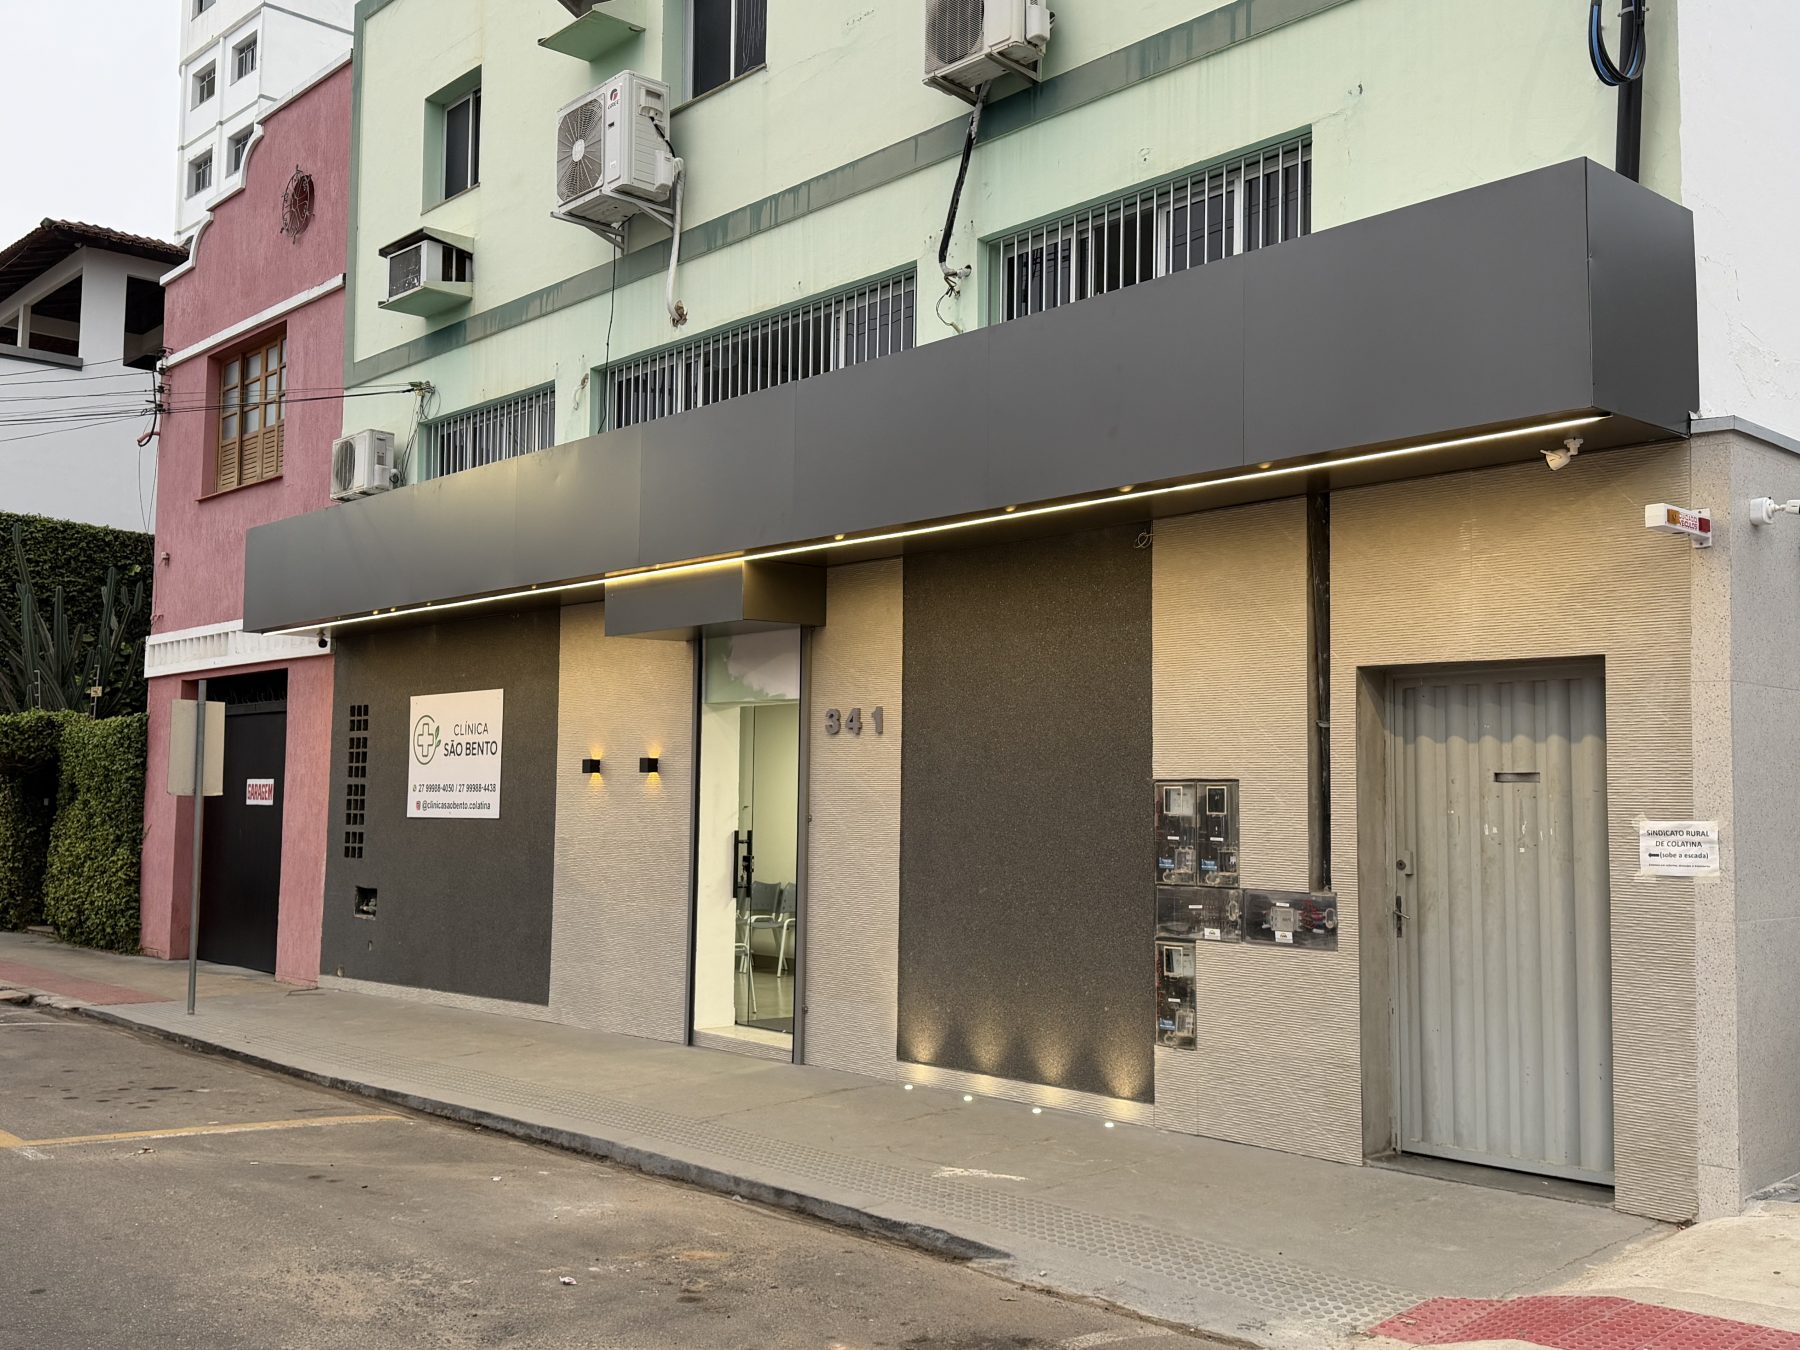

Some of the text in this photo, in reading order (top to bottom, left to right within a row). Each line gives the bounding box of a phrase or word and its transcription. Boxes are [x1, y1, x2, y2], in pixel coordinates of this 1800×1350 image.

[825, 706, 884, 735] 341
[453, 720, 489, 736] CLÍNICA
[443, 740, 498, 757] SÃO BENTO
[247, 783, 272, 800] GARAGEM
[418, 783, 424, 793] 27
[458, 783, 465, 793] 27
[422, 800, 491, 811] @clinicasaobento.colatina
[1646, 829, 1685, 837] SINDICATO
[1684, 852, 1709, 860] escada)
